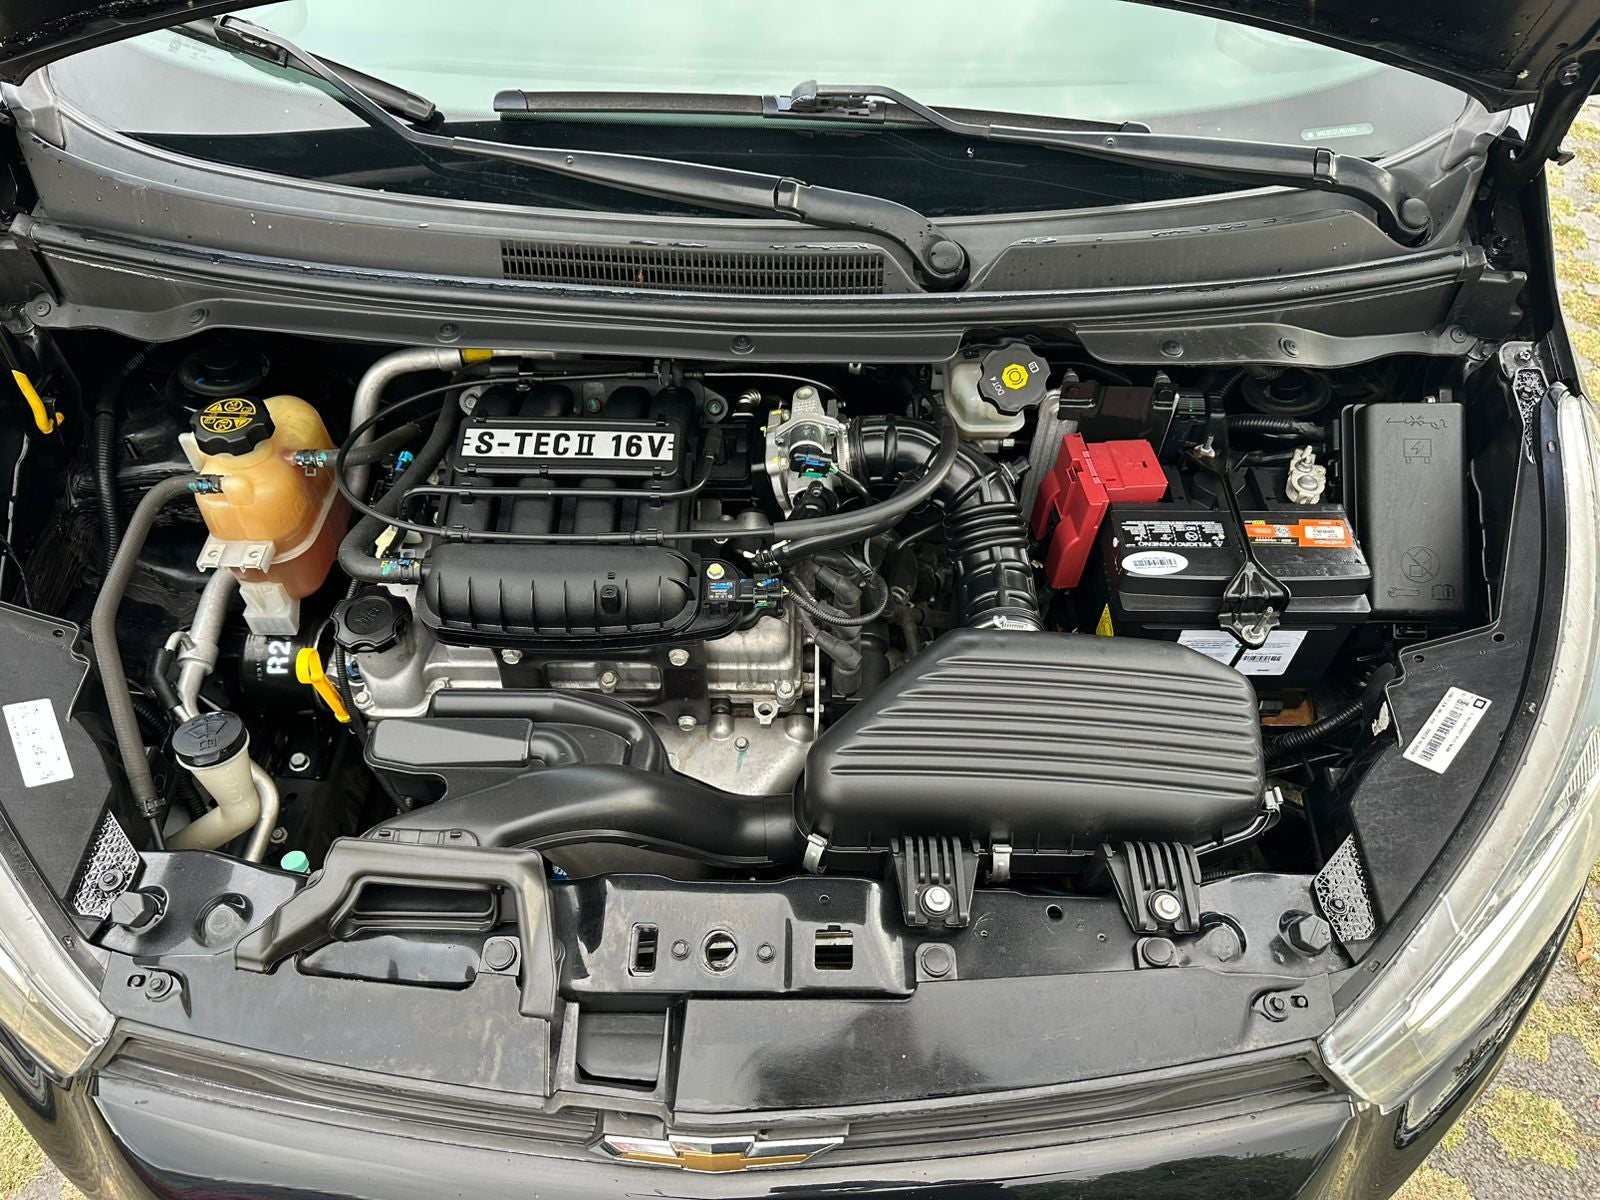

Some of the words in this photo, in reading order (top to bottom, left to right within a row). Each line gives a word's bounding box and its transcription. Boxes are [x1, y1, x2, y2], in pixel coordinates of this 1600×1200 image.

[992, 381, 1005, 396] DOT
[611, 433, 667, 458] 16V
[266, 641, 292, 674] R2
